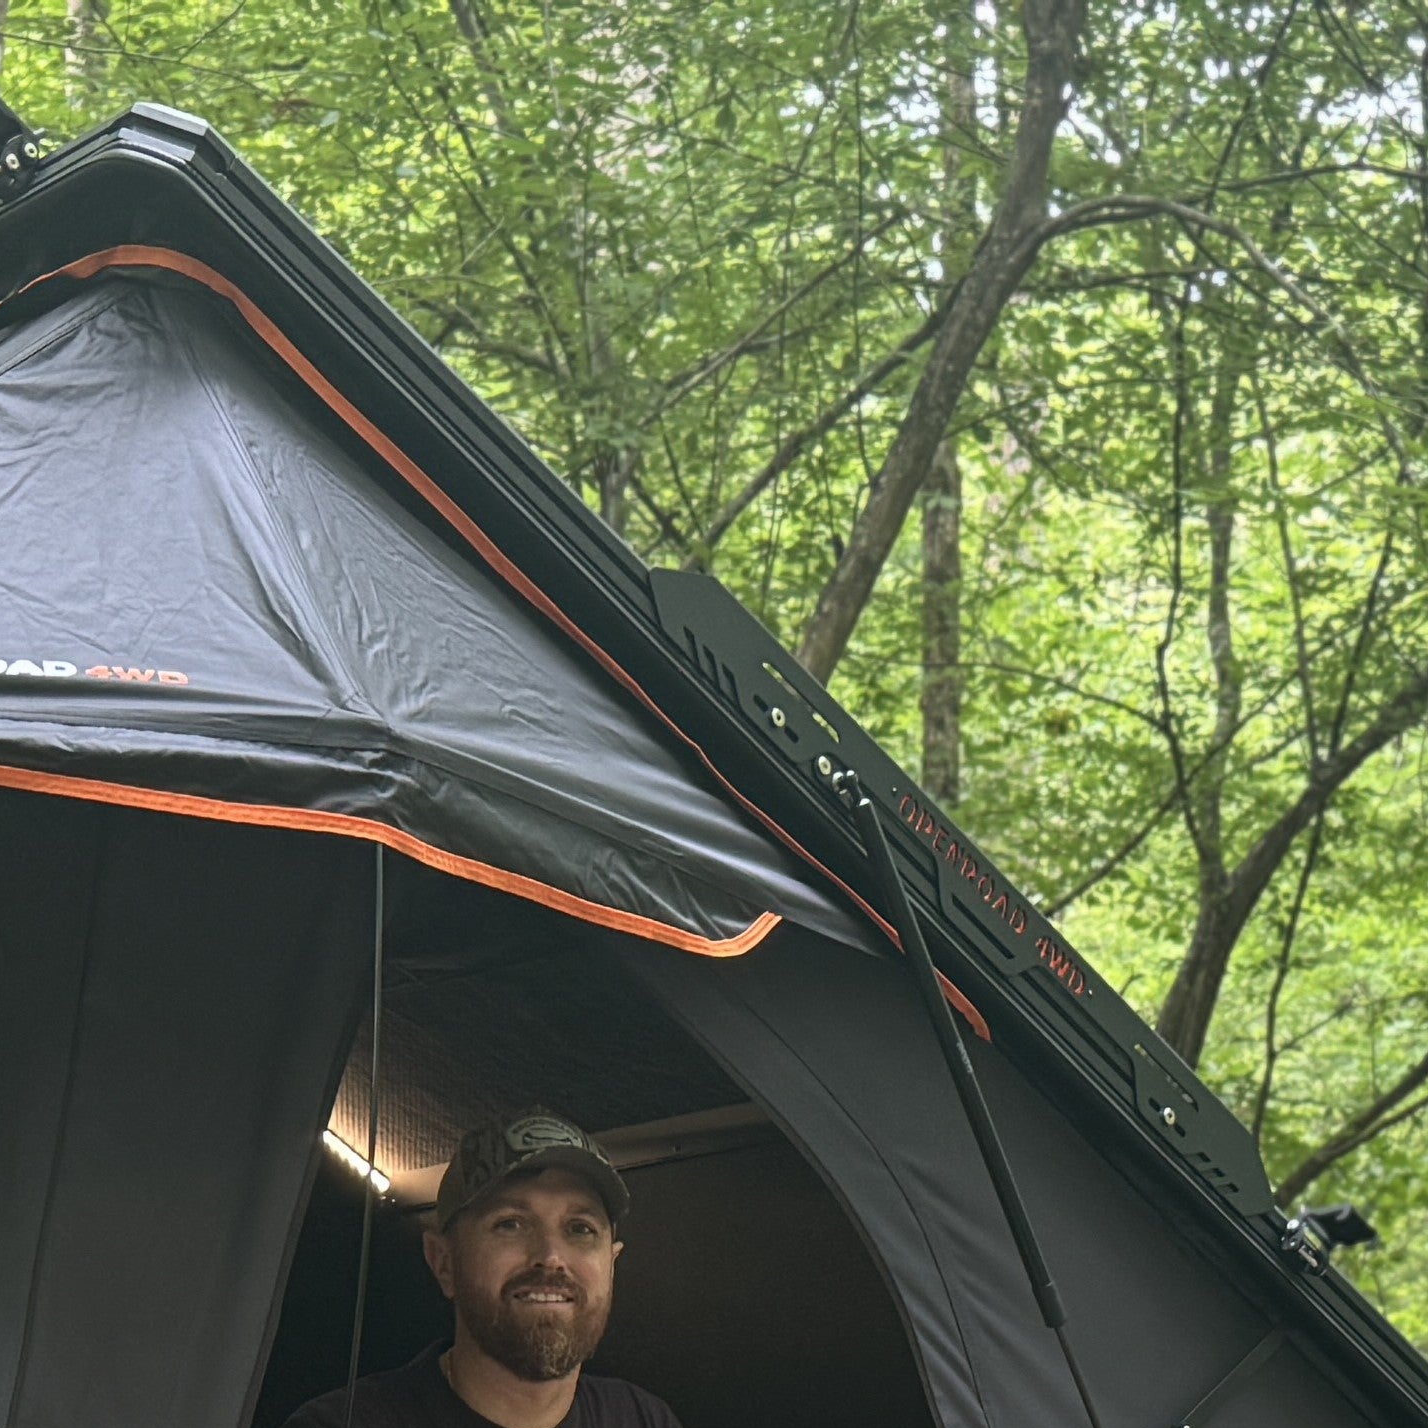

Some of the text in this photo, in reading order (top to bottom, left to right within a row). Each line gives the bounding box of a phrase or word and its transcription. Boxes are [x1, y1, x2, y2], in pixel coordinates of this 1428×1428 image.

[84, 664, 190, 686] 4WD
[899, 793, 1086, 996] OPENROAD 4WD
